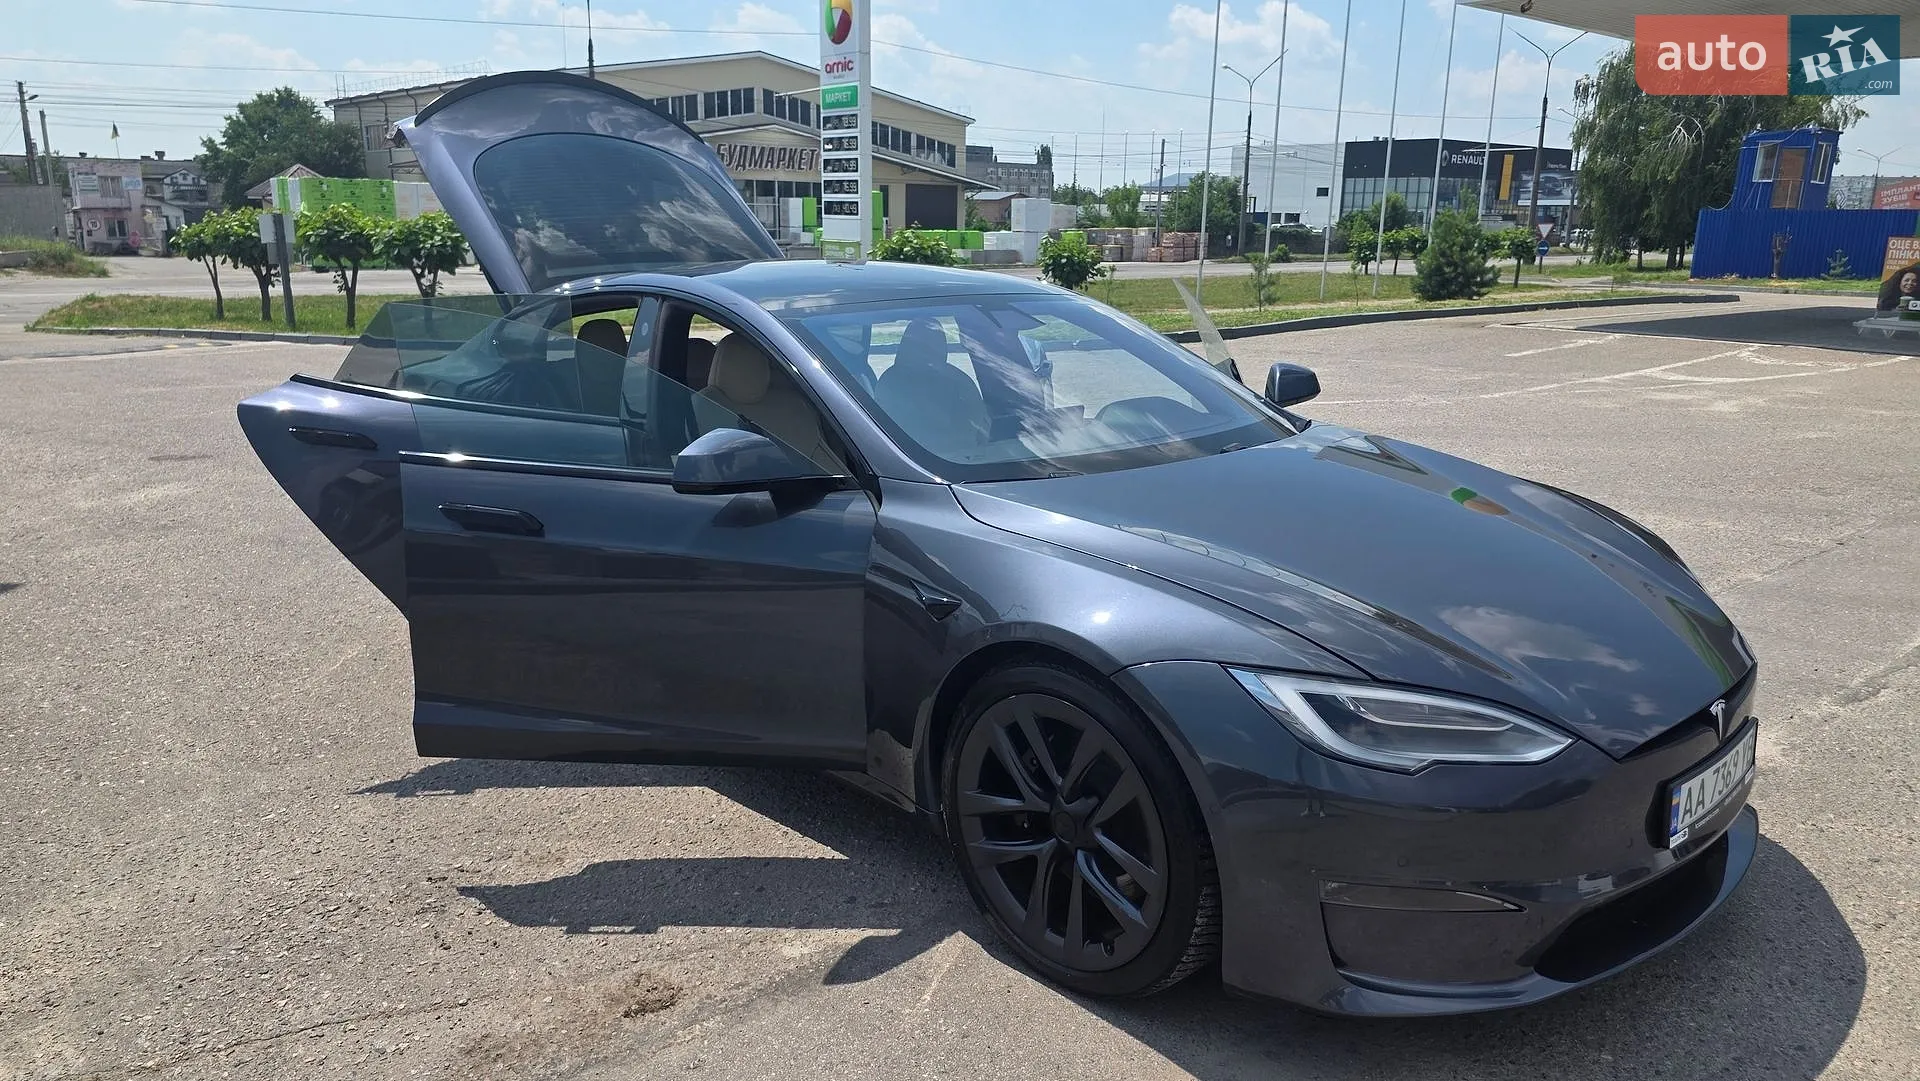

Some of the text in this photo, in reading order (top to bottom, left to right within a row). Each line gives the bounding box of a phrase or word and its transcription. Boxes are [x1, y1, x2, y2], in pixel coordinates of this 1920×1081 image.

[717, 143, 818, 171] БУДМАРКЕТ
[1889, 239, 1911, 249] ОЦЕ
[1711, 750, 1740, 804] 7369
